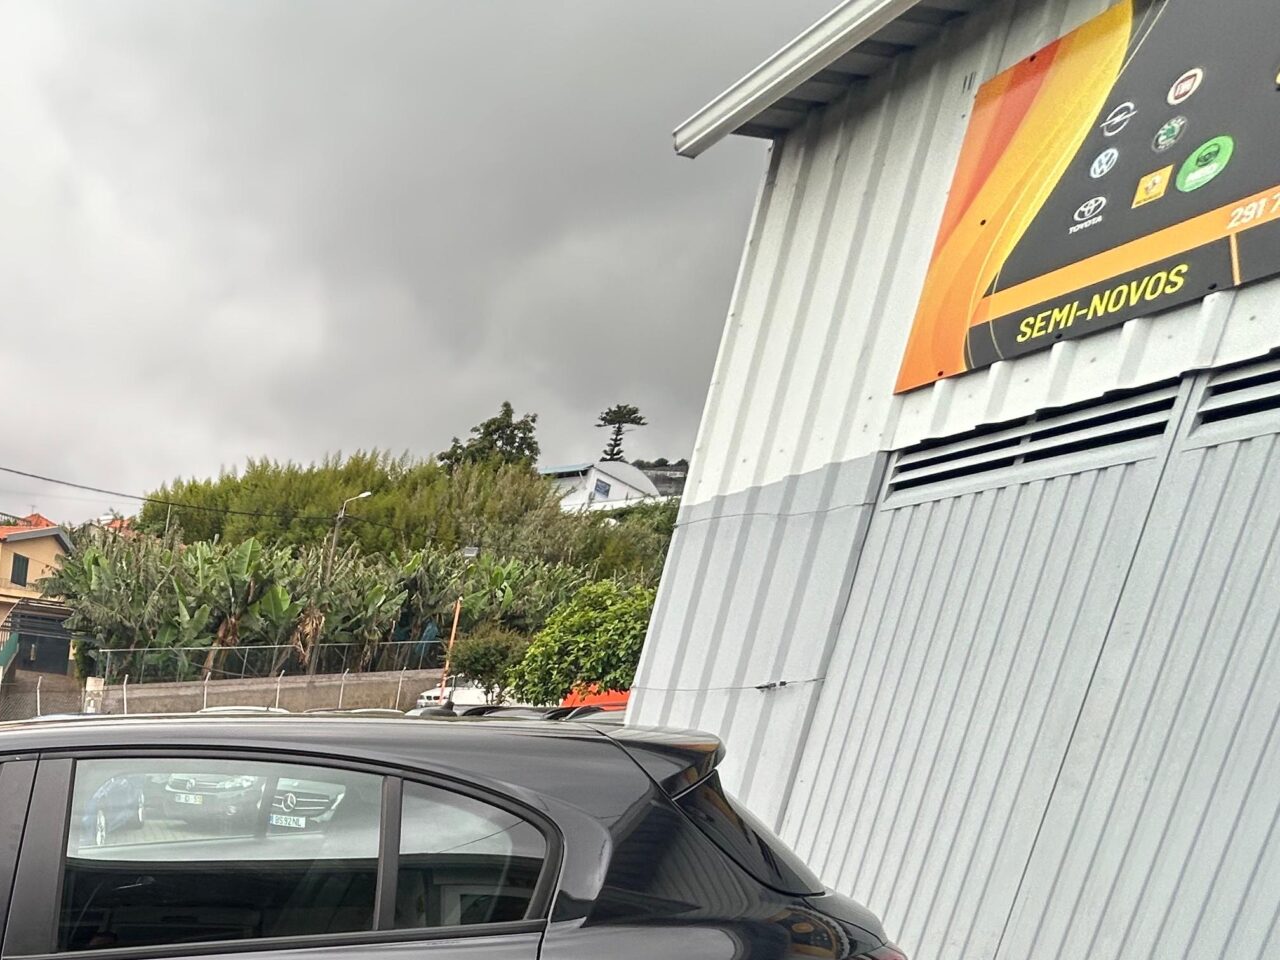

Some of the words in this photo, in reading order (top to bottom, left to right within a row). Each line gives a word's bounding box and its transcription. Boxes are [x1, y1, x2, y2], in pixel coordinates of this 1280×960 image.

[1068, 215, 1103, 235] TOYOTA
[1227, 198, 1268, 230] 291
[1016, 263, 1189, 343] SEMI-NOVOS
